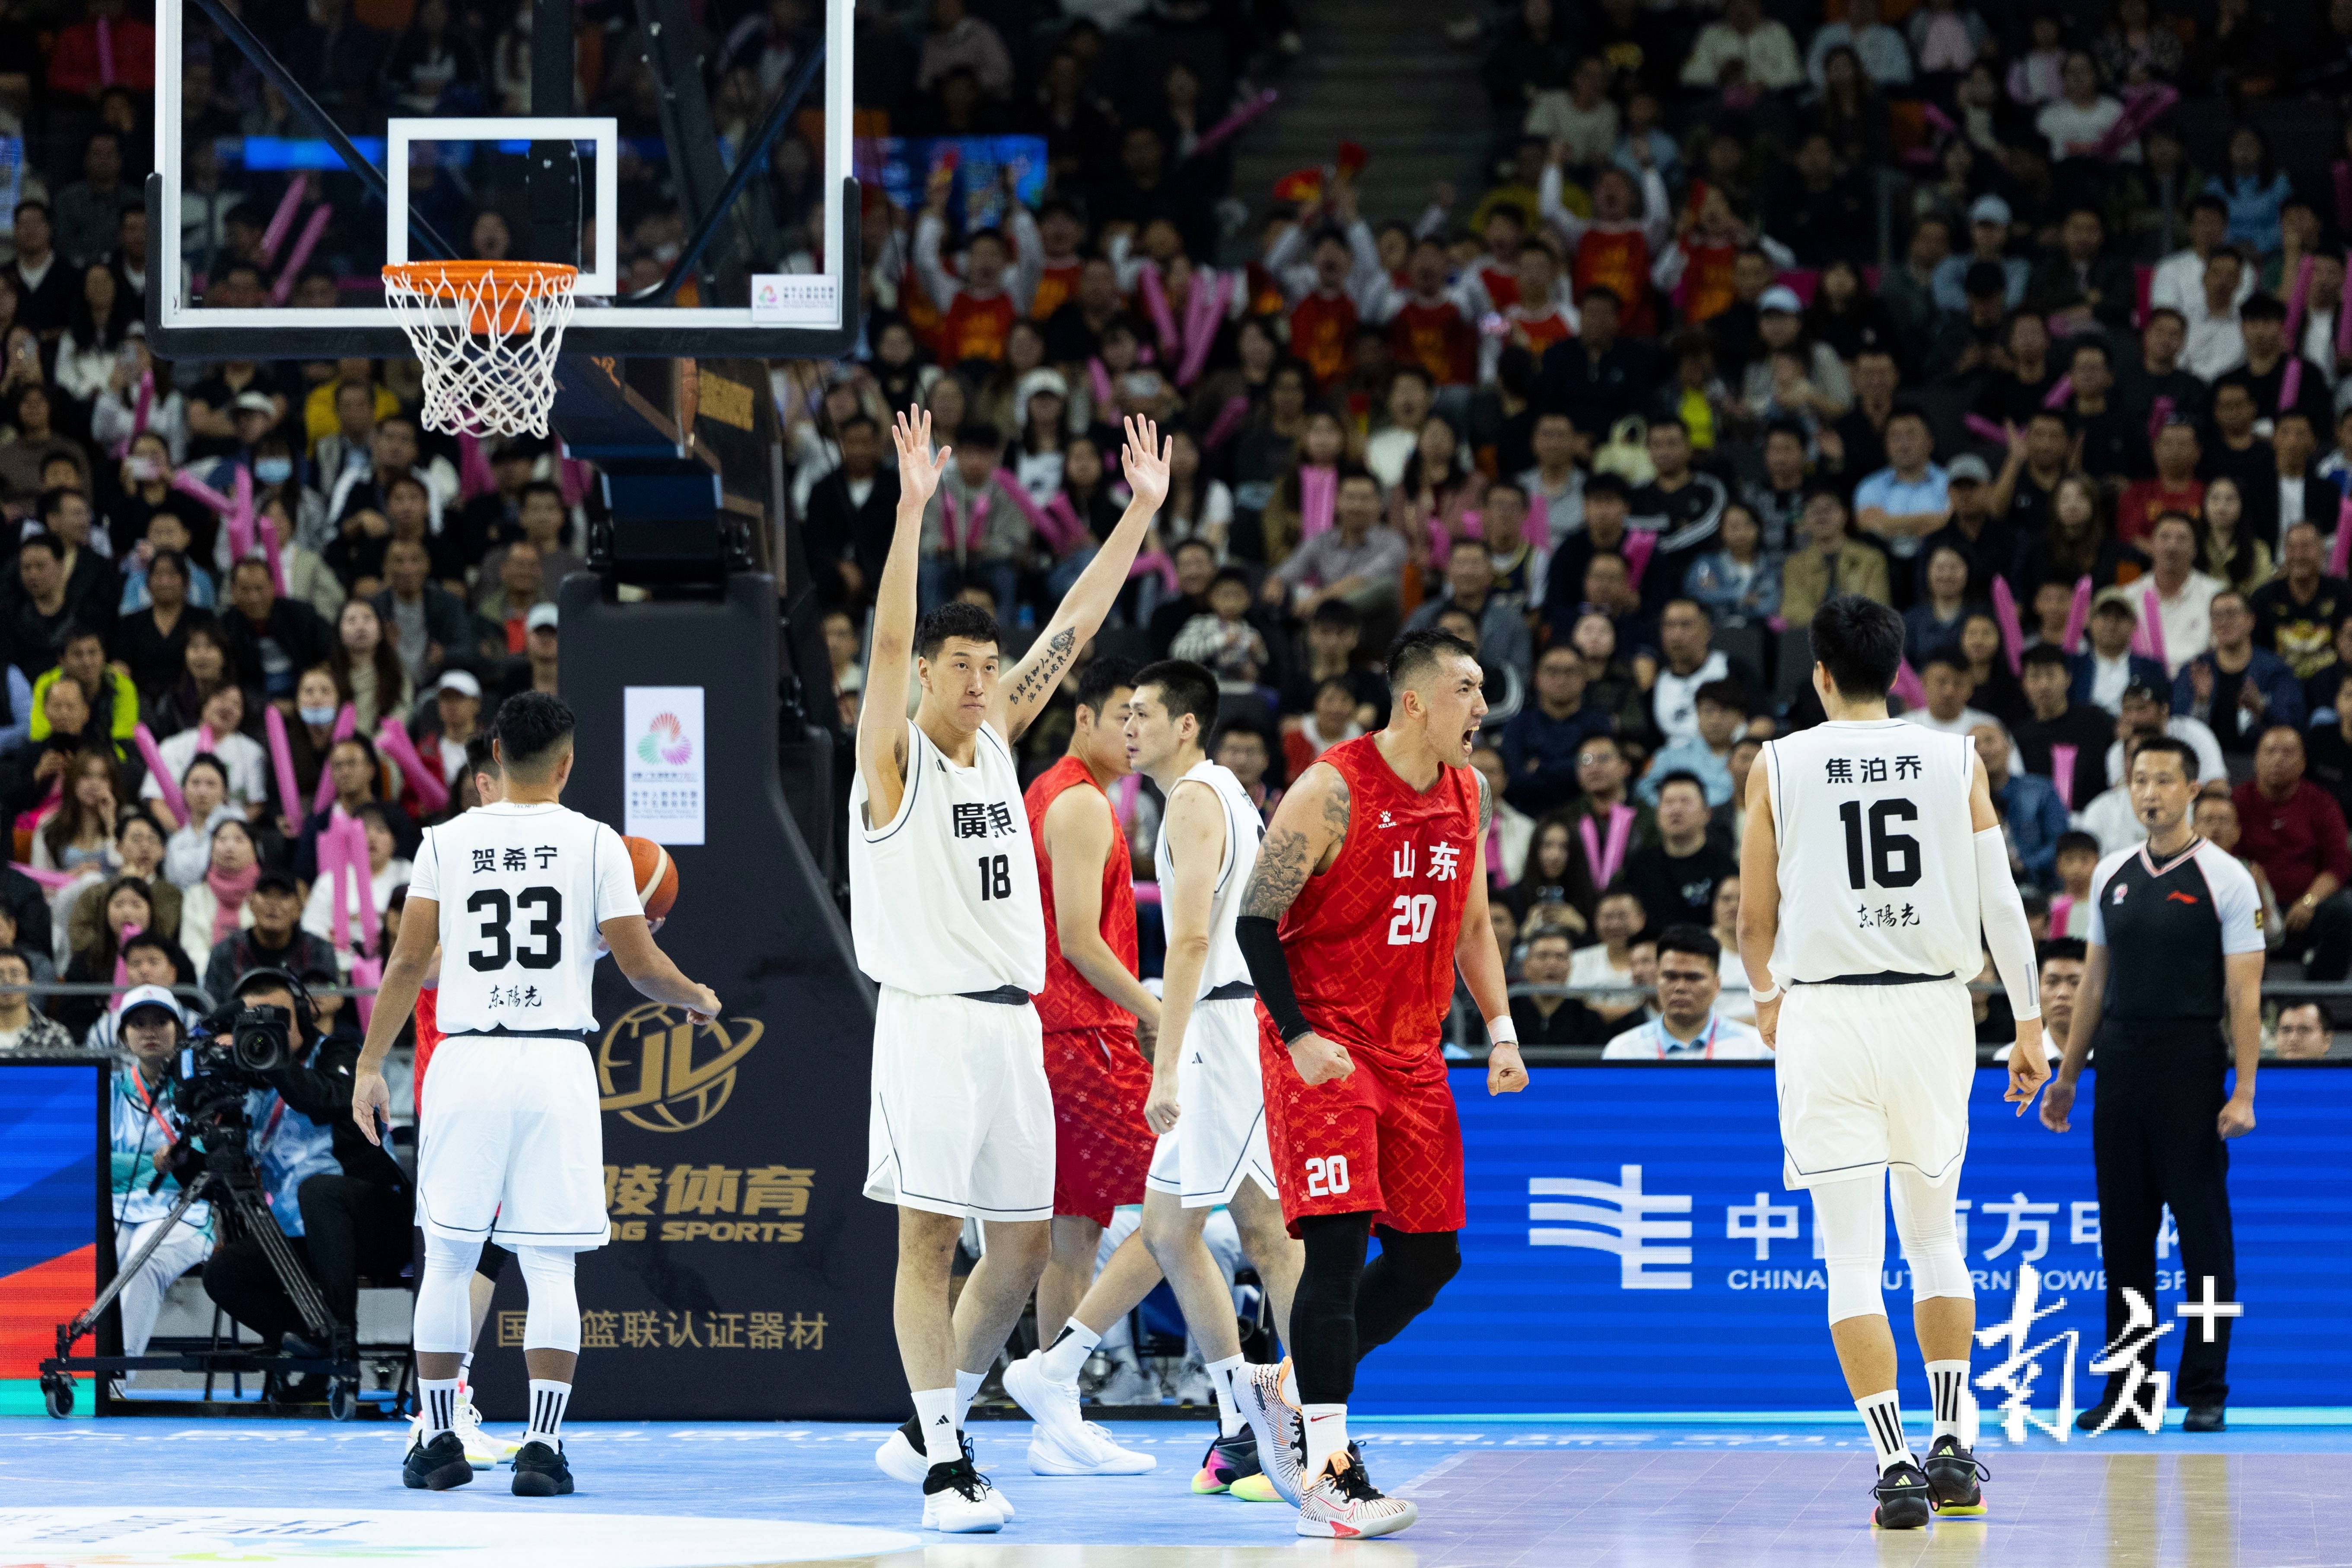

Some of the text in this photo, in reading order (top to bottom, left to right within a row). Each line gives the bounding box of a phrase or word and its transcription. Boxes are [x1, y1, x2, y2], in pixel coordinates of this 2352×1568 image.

[1826, 755, 1922, 783] 焦泊乔
[472, 845, 557, 874] 贺希宁
[1394, 841, 1460, 881] 山东
[1840, 798, 1921, 889] 16
[979, 854, 1012, 901] 18
[467, 886, 562, 972] 33
[1387, 894, 1437, 945] 20
[603, 1164, 815, 1215] 陵体育
[1305, 1155, 1350, 1197] 20
[659, 1221, 805, 1243] SPORTS
[1728, 1269, 1827, 1290] CHINA
[497, 1309, 829, 1351] 国篮联认证器材
